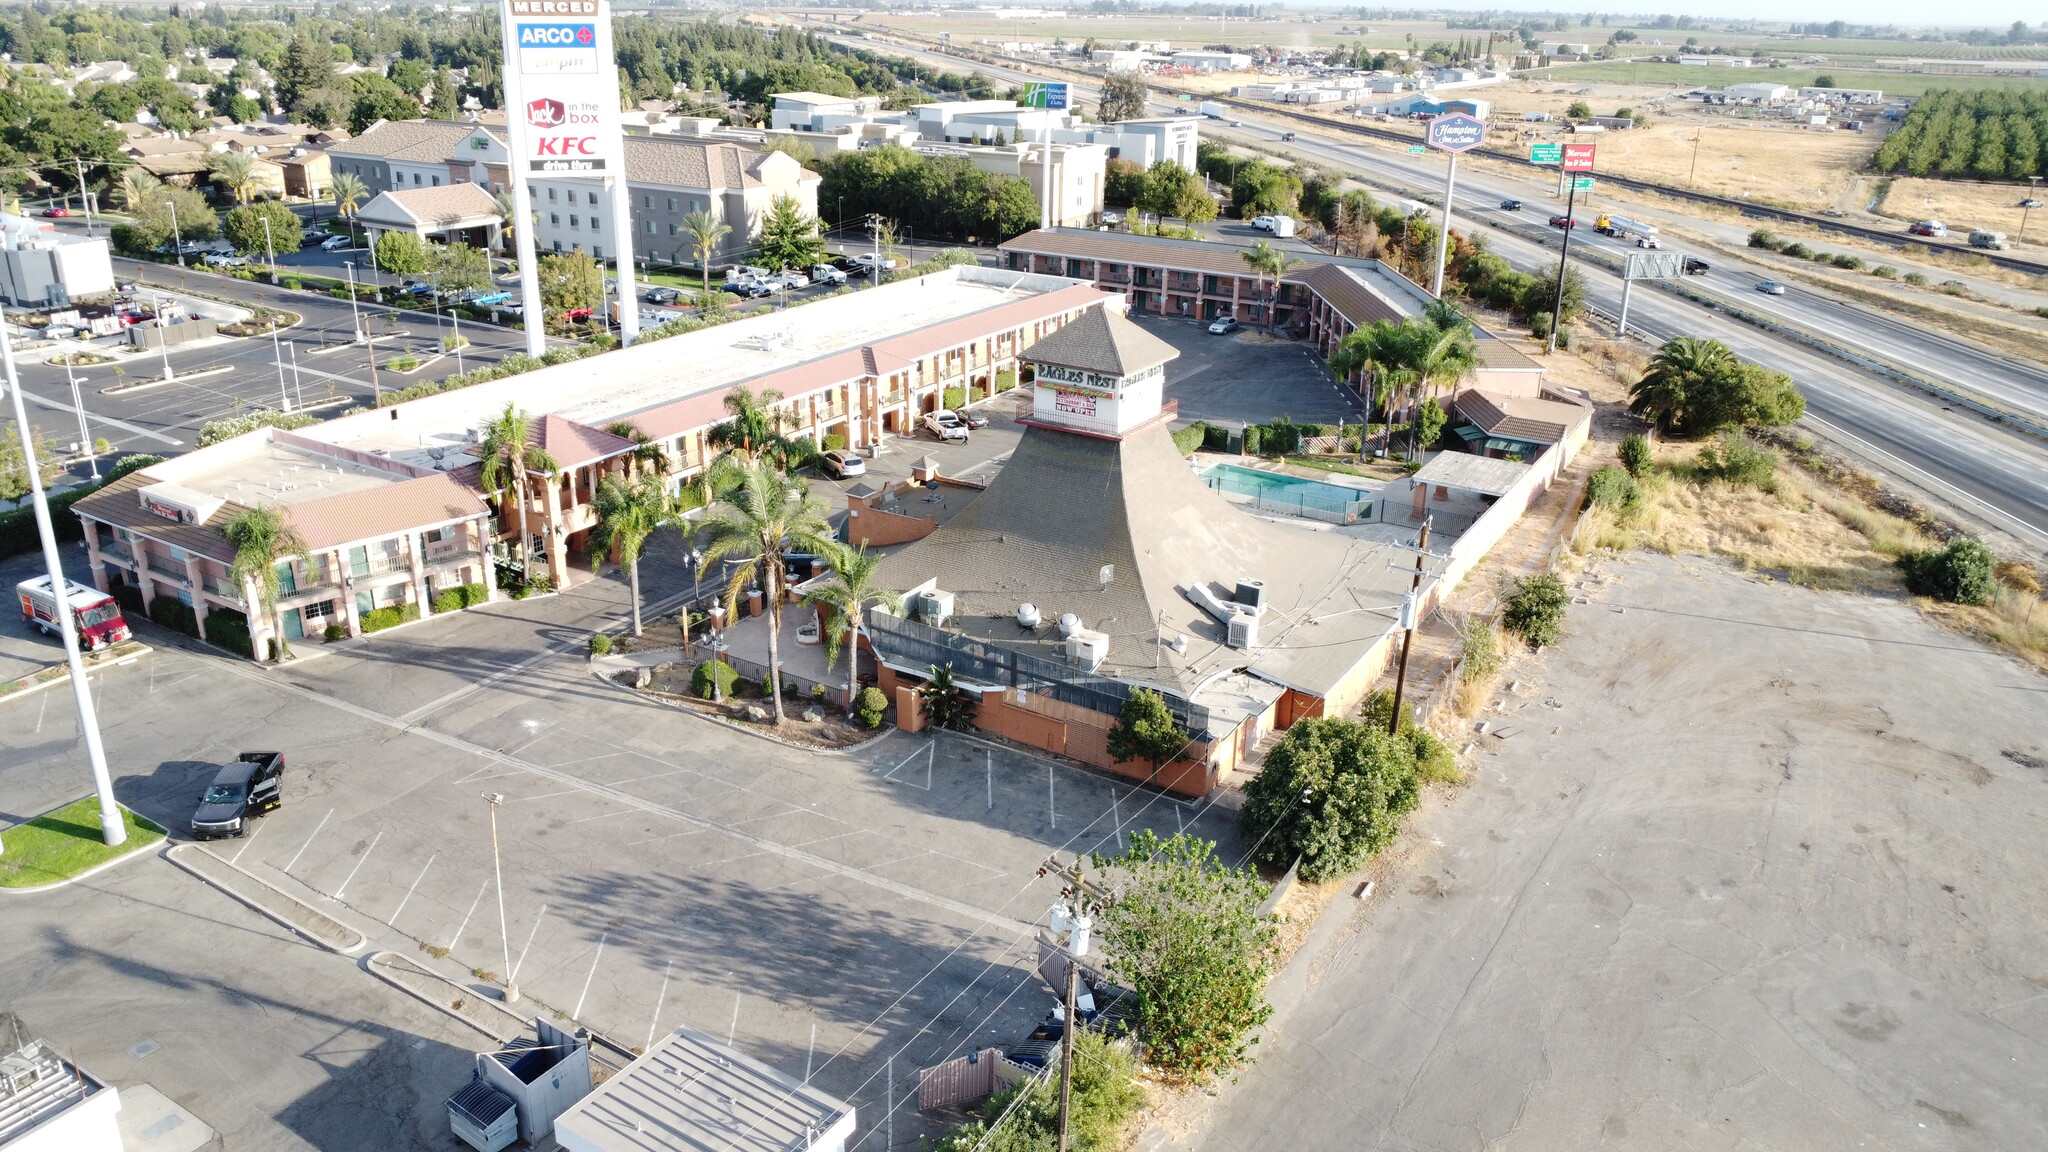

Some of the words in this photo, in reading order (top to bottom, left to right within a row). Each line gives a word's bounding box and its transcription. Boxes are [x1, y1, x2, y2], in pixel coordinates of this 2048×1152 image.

[514, 2, 595, 13] MERCED
[522, 28, 574, 43] ARCO
[528, 101, 564, 125] Jack
[570, 113, 599, 123] box
[1435, 124, 1480, 136] Hampton
[537, 137, 596, 155] KFC
[543, 161, 569, 170] drive
[571, 160, 593, 170] thru
[1038, 364, 1084, 384] EAGLES
[1086, 373, 1117, 389] NEST
[1075, 407, 1095, 416] OPEN
